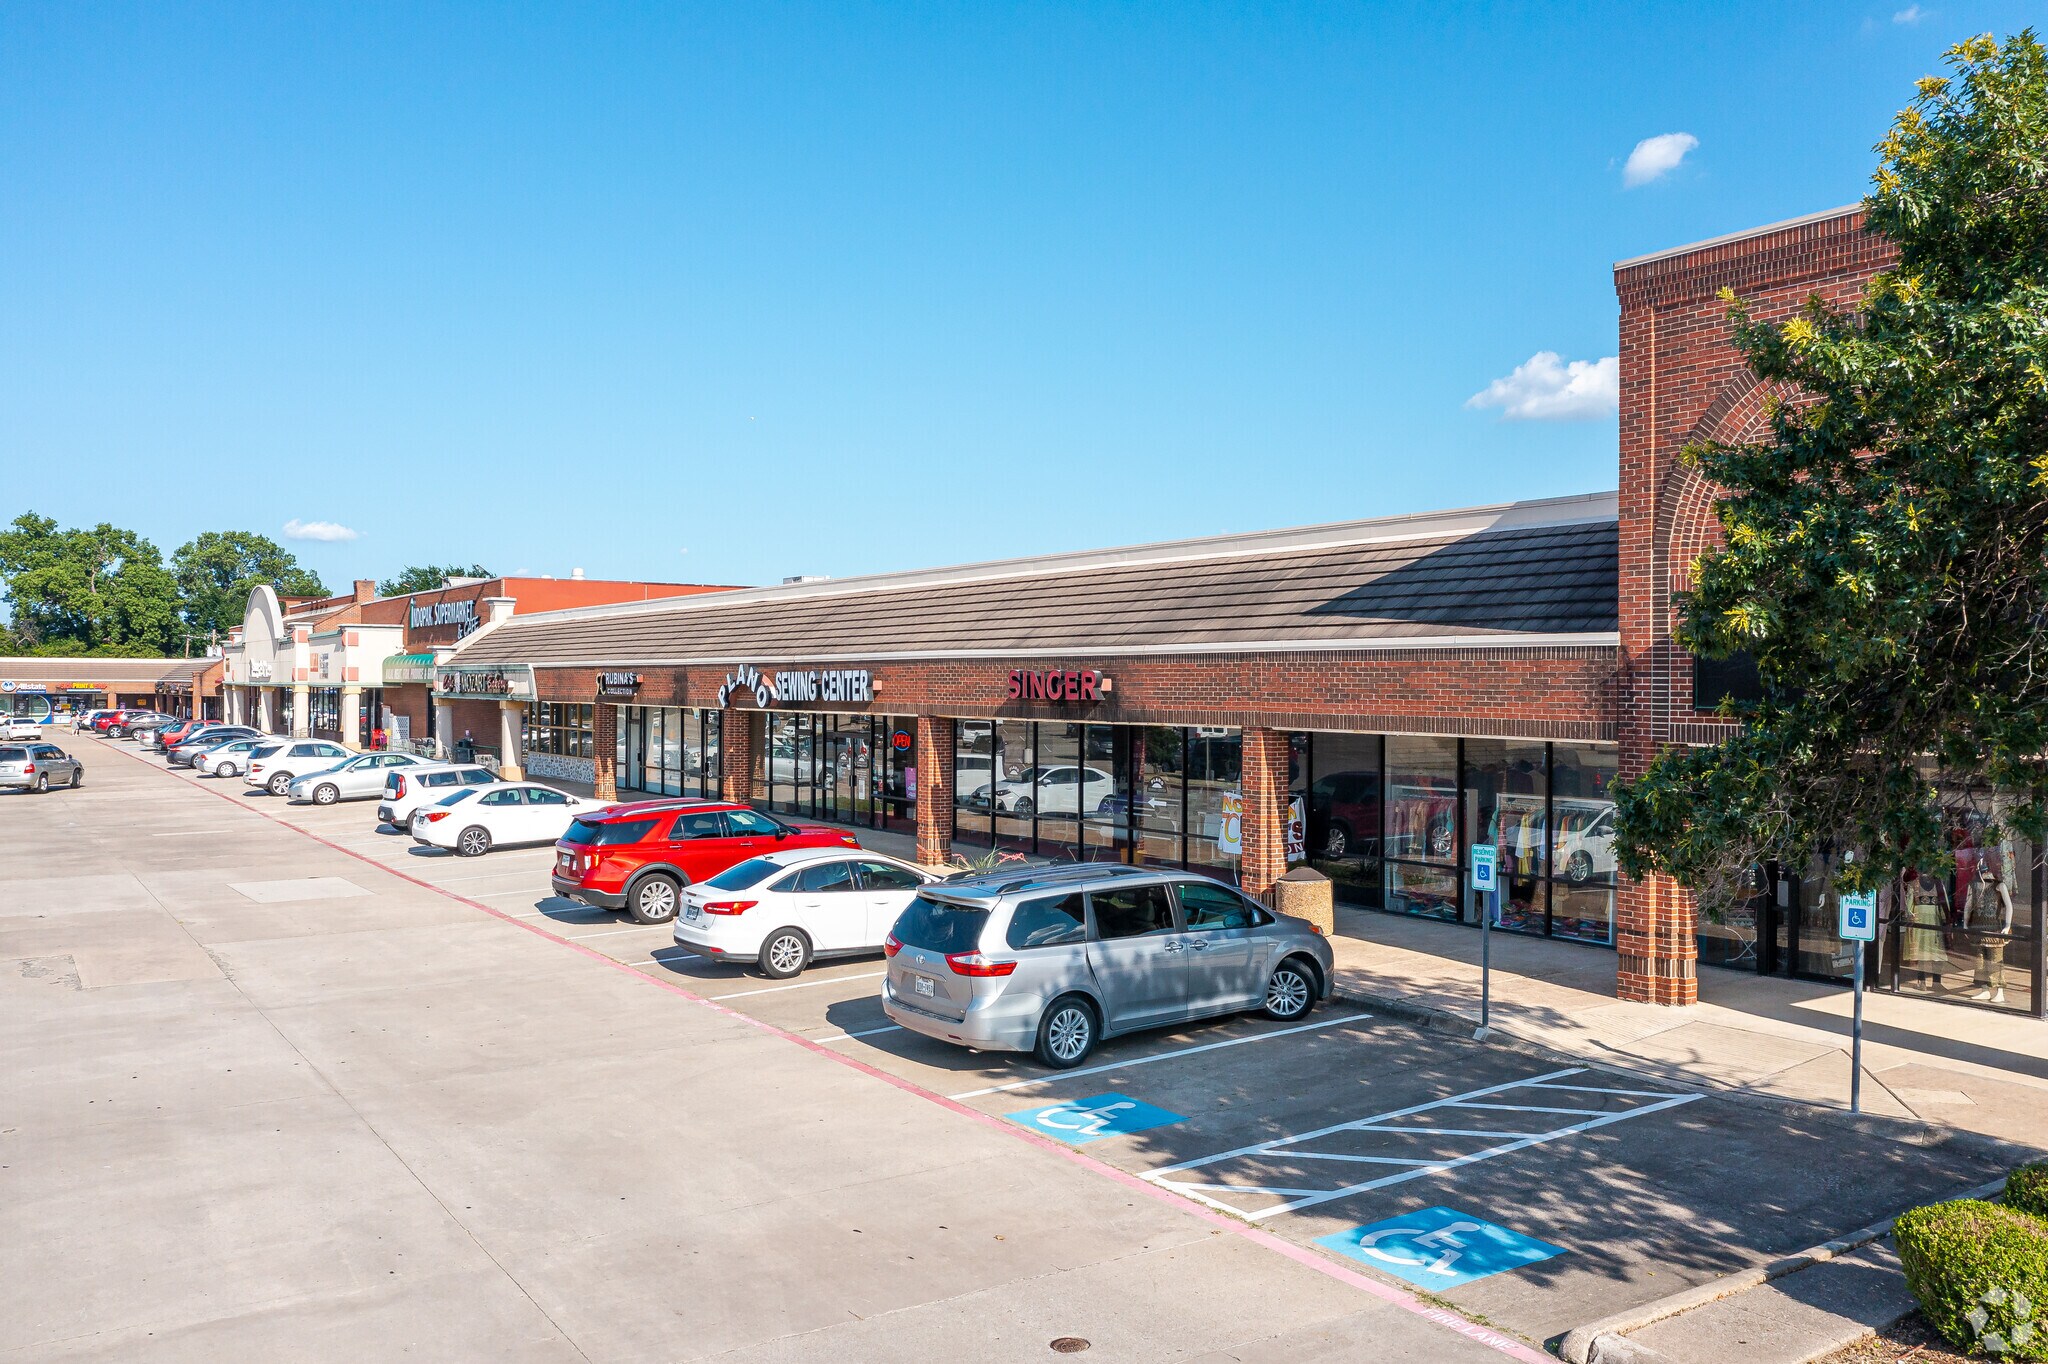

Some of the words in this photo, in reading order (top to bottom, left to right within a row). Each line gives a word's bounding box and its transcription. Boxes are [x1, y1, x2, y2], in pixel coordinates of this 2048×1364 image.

[434, 600, 474, 626] SUPERMARKET
[17, 682, 47, 690] Allstate
[606, 672, 633, 685] RUBINA'S
[718, 664, 768, 708] PLANO
[776, 671, 817, 701] SEWING
[822, 670, 870, 701] CENTER
[1008, 669, 1100, 701] SINGER
[893, 734, 911, 747] OPEN
[1846, 899, 1871, 907] PARKING
[1420, 1308, 1466, 1329] FIRE
[1461, 1326, 1513, 1351] LANE
